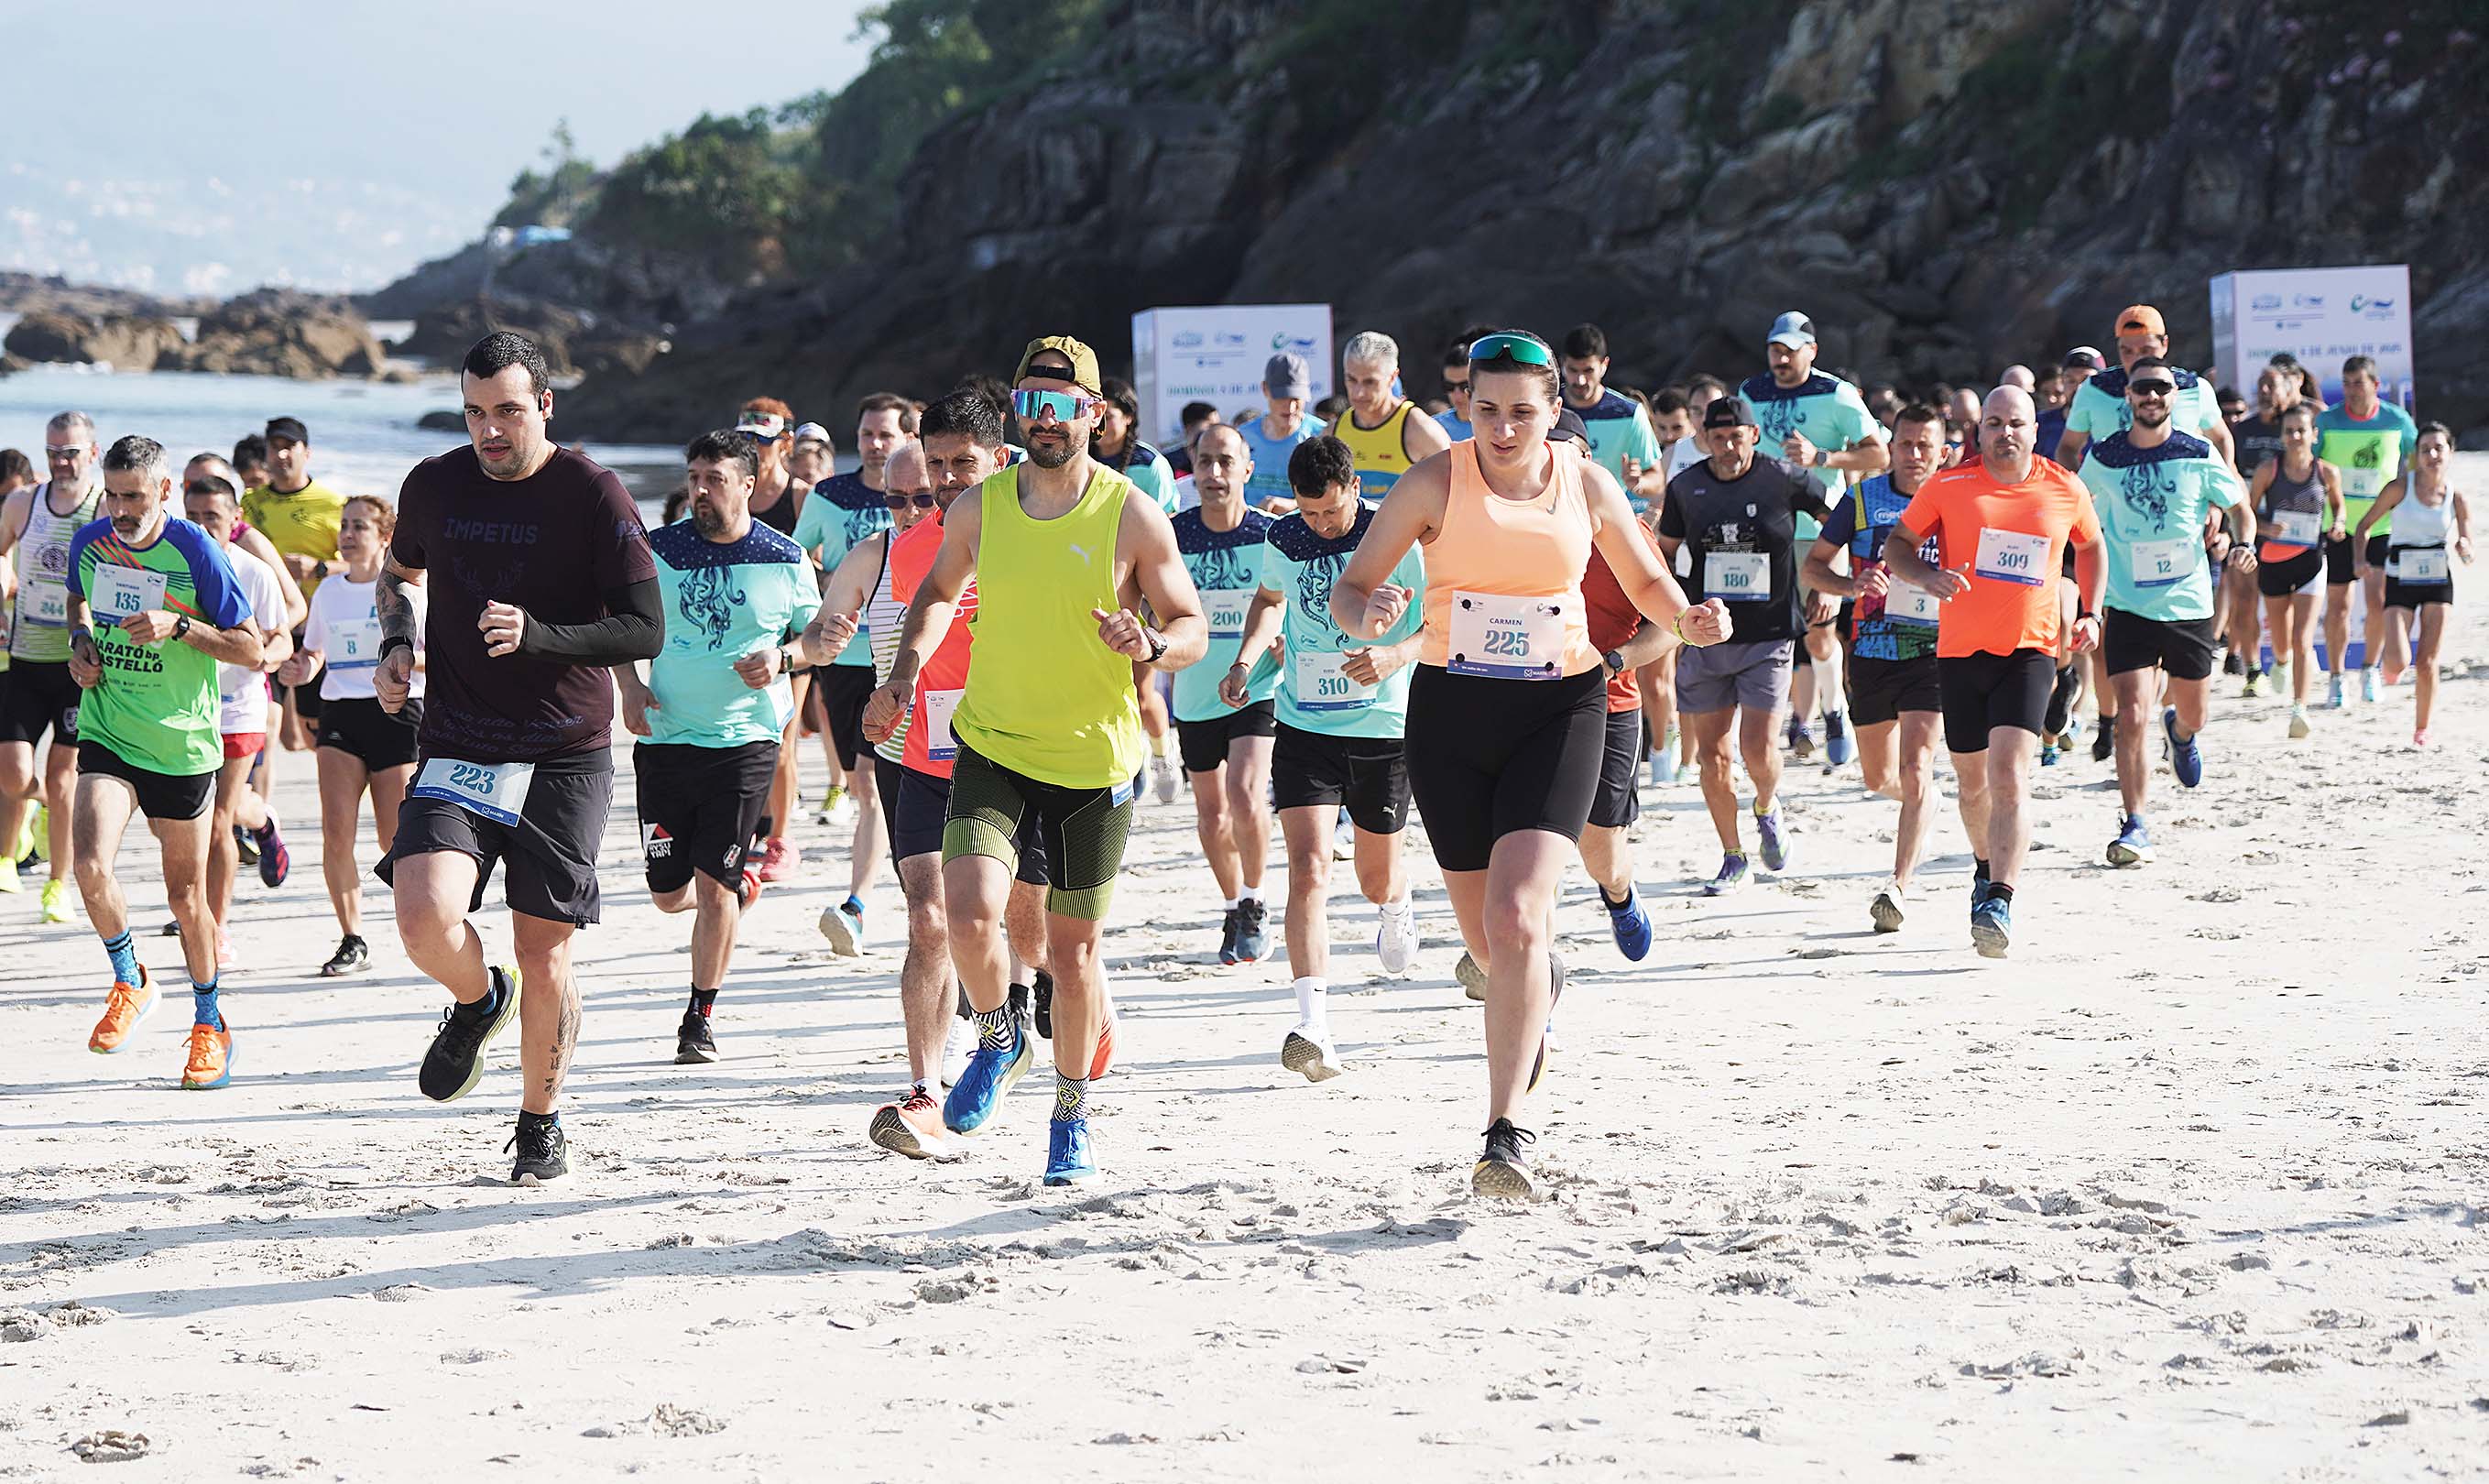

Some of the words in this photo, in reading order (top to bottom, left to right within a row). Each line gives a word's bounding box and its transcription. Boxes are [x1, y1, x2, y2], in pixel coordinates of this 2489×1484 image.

[444, 518, 539, 544] IMPETUS
[1997, 551, 2029, 570] 309
[2156, 560, 2171, 573] 12
[1724, 573, 1749, 587] 180
[115, 592, 141, 612] 135
[1916, 598, 1925, 613] 3
[1212, 611, 1242, 626] 200
[1489, 617, 1523, 626] CARMEN
[347, 640, 356, 654] 8
[1483, 629, 1530, 657] 225
[1318, 677, 1348, 695] 310
[449, 764, 497, 794] 223
